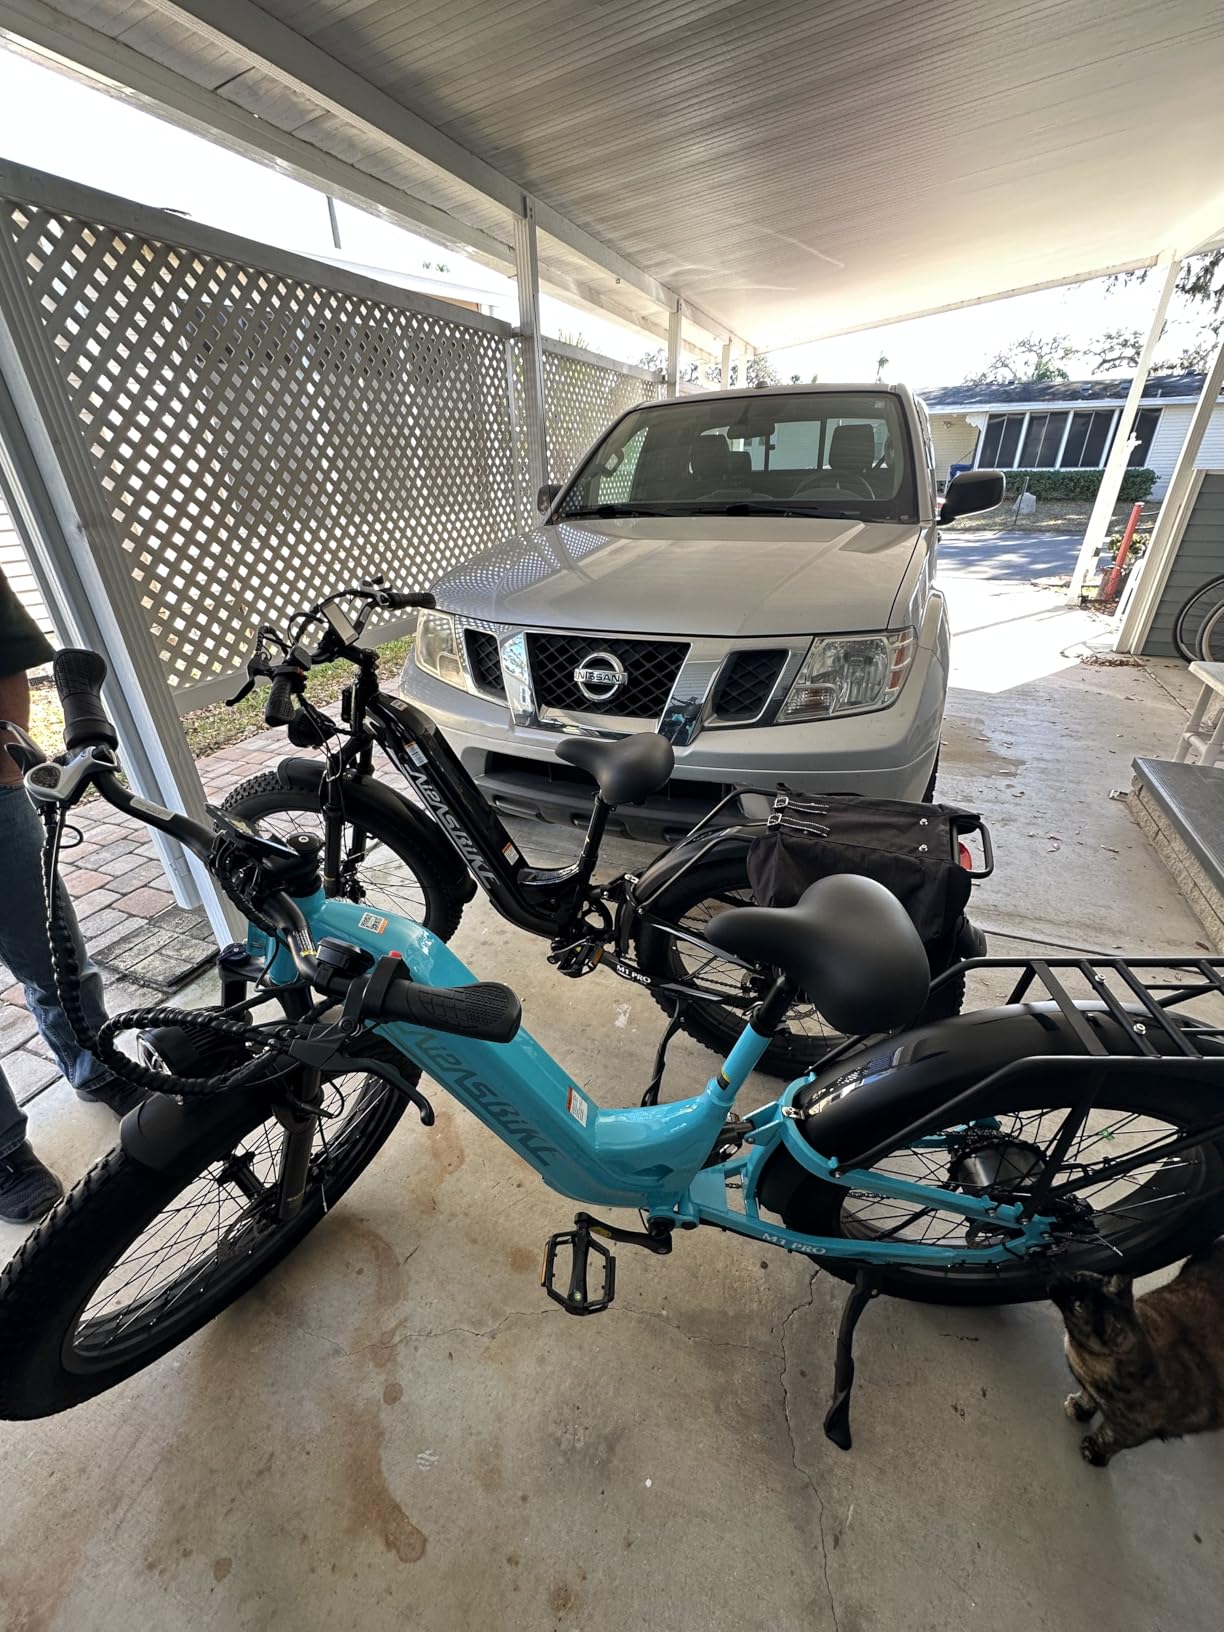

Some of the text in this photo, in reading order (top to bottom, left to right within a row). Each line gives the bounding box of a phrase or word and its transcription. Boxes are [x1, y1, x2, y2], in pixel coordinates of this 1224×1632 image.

[577, 669, 621, 683] NISSAN
[616, 964, 652, 984] M1 PRO
[762, 1232, 827, 1255] M1 PRO
